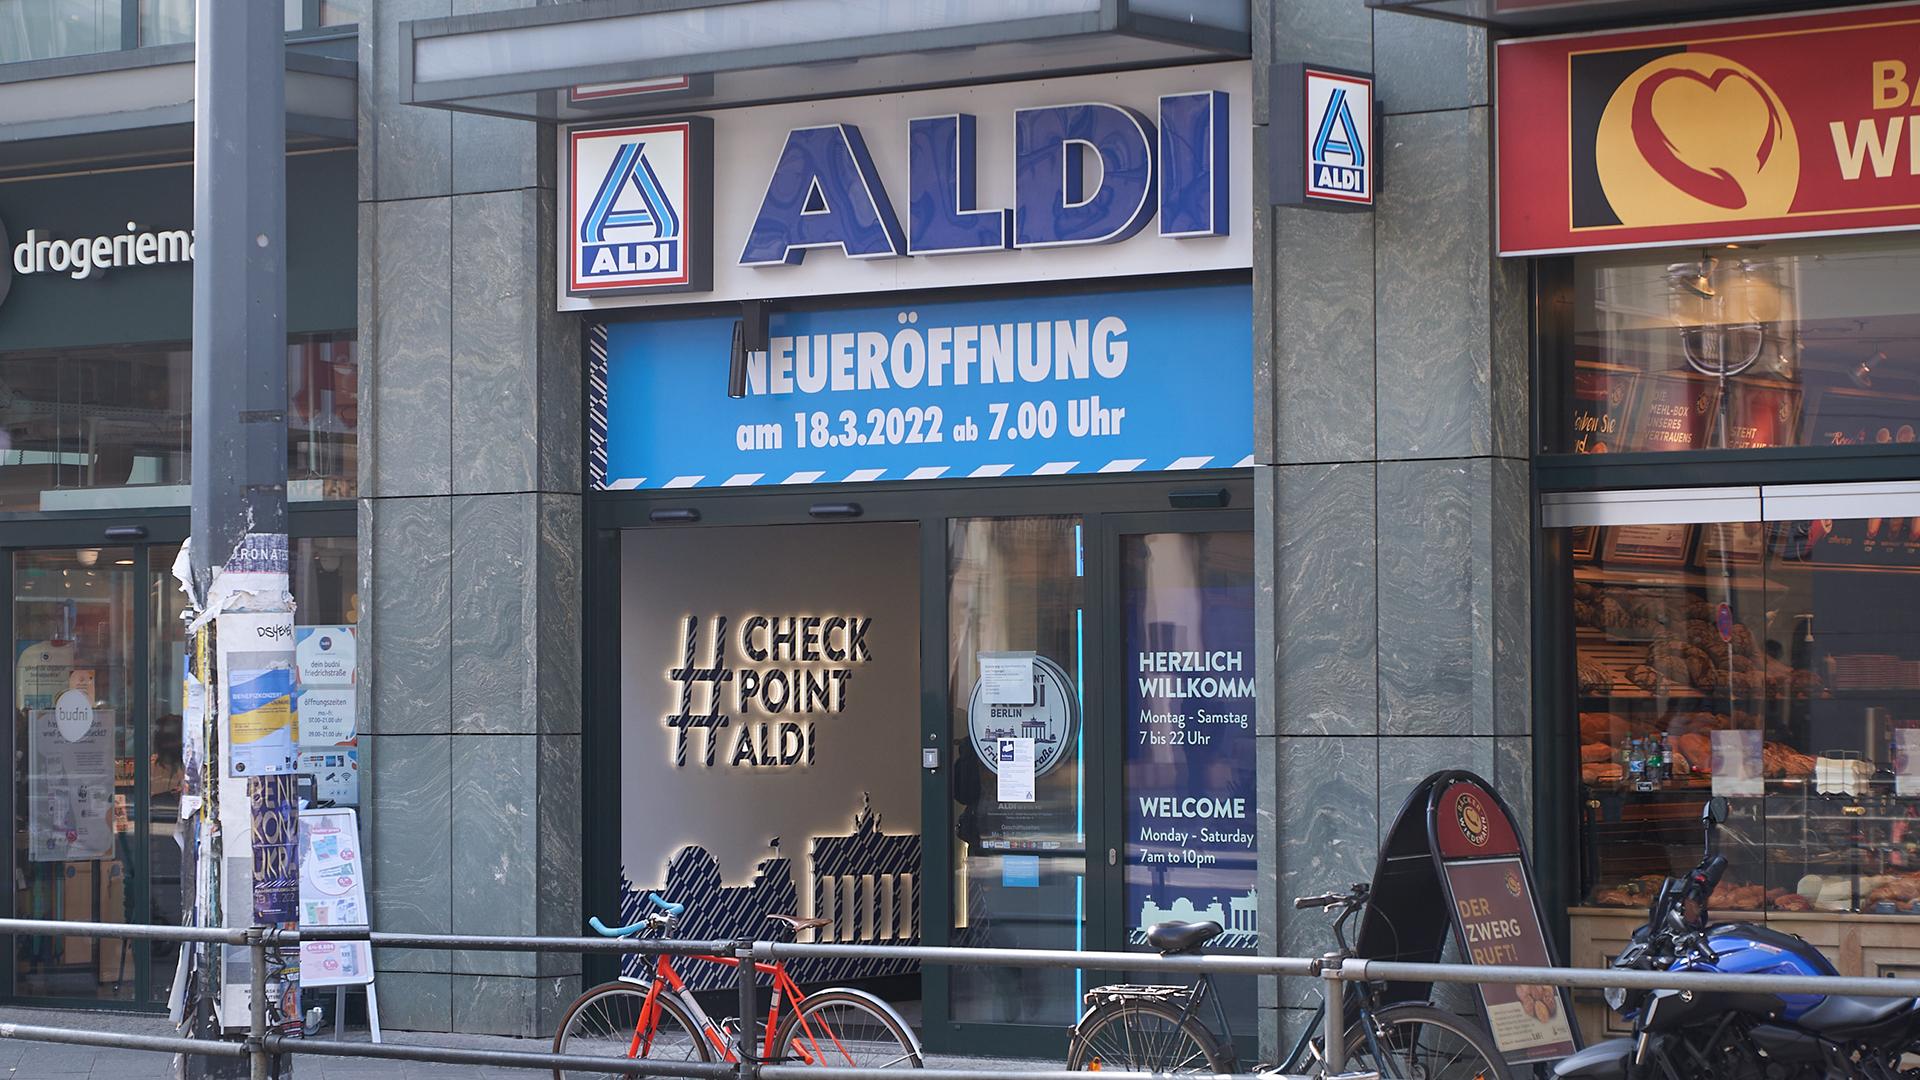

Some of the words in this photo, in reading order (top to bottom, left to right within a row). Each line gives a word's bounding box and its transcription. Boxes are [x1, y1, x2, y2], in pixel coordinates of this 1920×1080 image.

[736, 90, 1230, 267] ALDI
[1317, 166, 1361, 191] ALDI
[13, 221, 194, 280] drogeriem
[589, 243, 670, 274] ALDI
[1650, 404, 1690, 417] MEHL-BOX
[736, 422, 782, 451] am
[795, 406, 943, 448] 18.3.2022
[953, 416, 978, 442] ab
[988, 401, 1057, 440] 7.00
[1067, 395, 1125, 438] Uhr
[742, 616, 872, 662] CHECK
[1139, 651, 1242, 672] HERZLICH
[738, 668, 852, 714] POINT
[1138, 677, 1257, 698] WILLKOMM
[59, 706, 88, 721] budni
[990, 708, 1022, 718] BERLIN
[1140, 709, 1186, 729] Montag
[1197, 709, 1248, 729] Samstag
[730, 722, 816, 767] ALDI
[1140, 731, 1148, 745] 7
[1150, 730, 1166, 745] bis
[1169, 731, 1185, 745] 22
[1187, 730, 1211, 745] Uhr
[1139, 797, 1246, 819] WELCOME
[1140, 827, 1189, 847] Monday
[1200, 828, 1255, 848] Saturday
[1140, 849, 1165, 863] 7am
[1168, 851, 1180, 863] to
[1182, 850, 1216, 869] 10pm
[1459, 898, 1491, 918] DER
[1466, 919, 1521, 943] ZWERG
[1473, 943, 1519, 966] RUFT!
